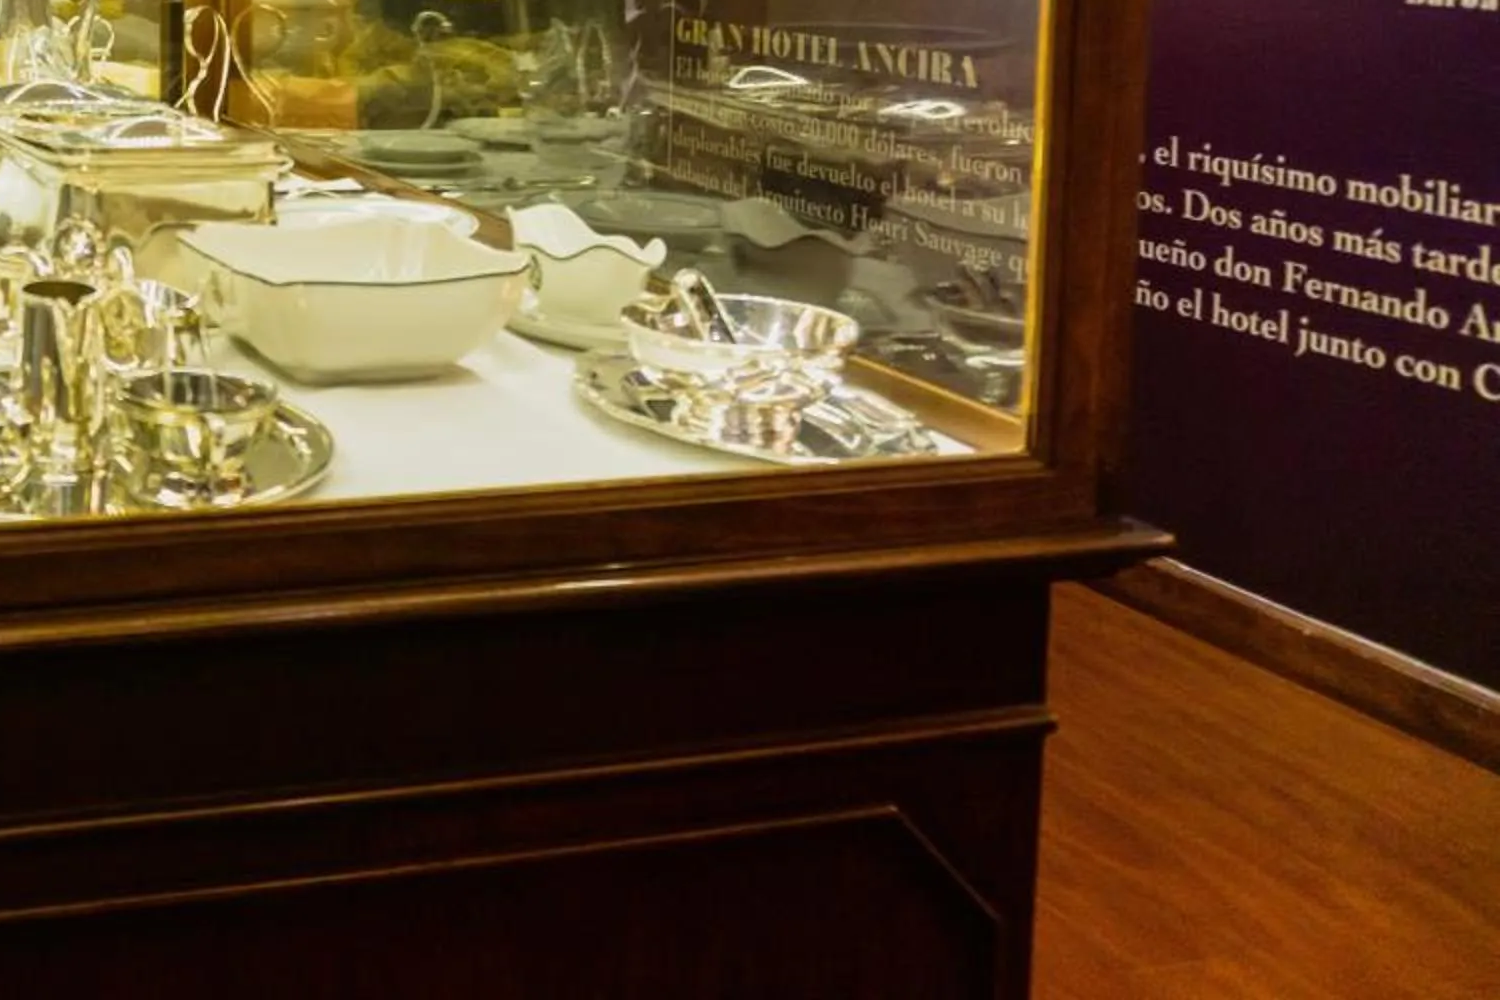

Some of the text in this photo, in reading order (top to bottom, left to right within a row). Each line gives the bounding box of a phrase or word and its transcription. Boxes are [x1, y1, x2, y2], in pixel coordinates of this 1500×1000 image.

[676, 17, 978, 89] GRAN HOTEL ANCIRA
[767, 144, 794, 173] fue
[797, 151, 876, 193] devuelto
[880, 172, 897, 201] el
[904, 173, 957, 214] hotel
[962, 200, 975, 217] a
[981, 203, 1005, 225] su
[1138, 239, 1207, 271] ueño
[1214, 245, 1272, 288] don
[1283, 260, 1449, 331] Fernando
[951, 144, 1023, 185] fueron
[1183, 189, 1242, 230] Dos
[1250, 209, 1324, 247] años
[1333, 228, 1402, 264] más
[1154, 136, 1179, 167] el
[1187, 143, 1337, 197] riquísimo
[1346, 174, 1500, 227] mobiliar
[723, 171, 747, 200] del
[914, 222, 1003, 272] Sauvage
[1135, 279, 1169, 311] ño
[1177, 288, 1202, 321] el
[1212, 292, 1288, 344] hotel
[1294, 315, 1386, 369] junto
[1395, 353, 1461, 391] con
